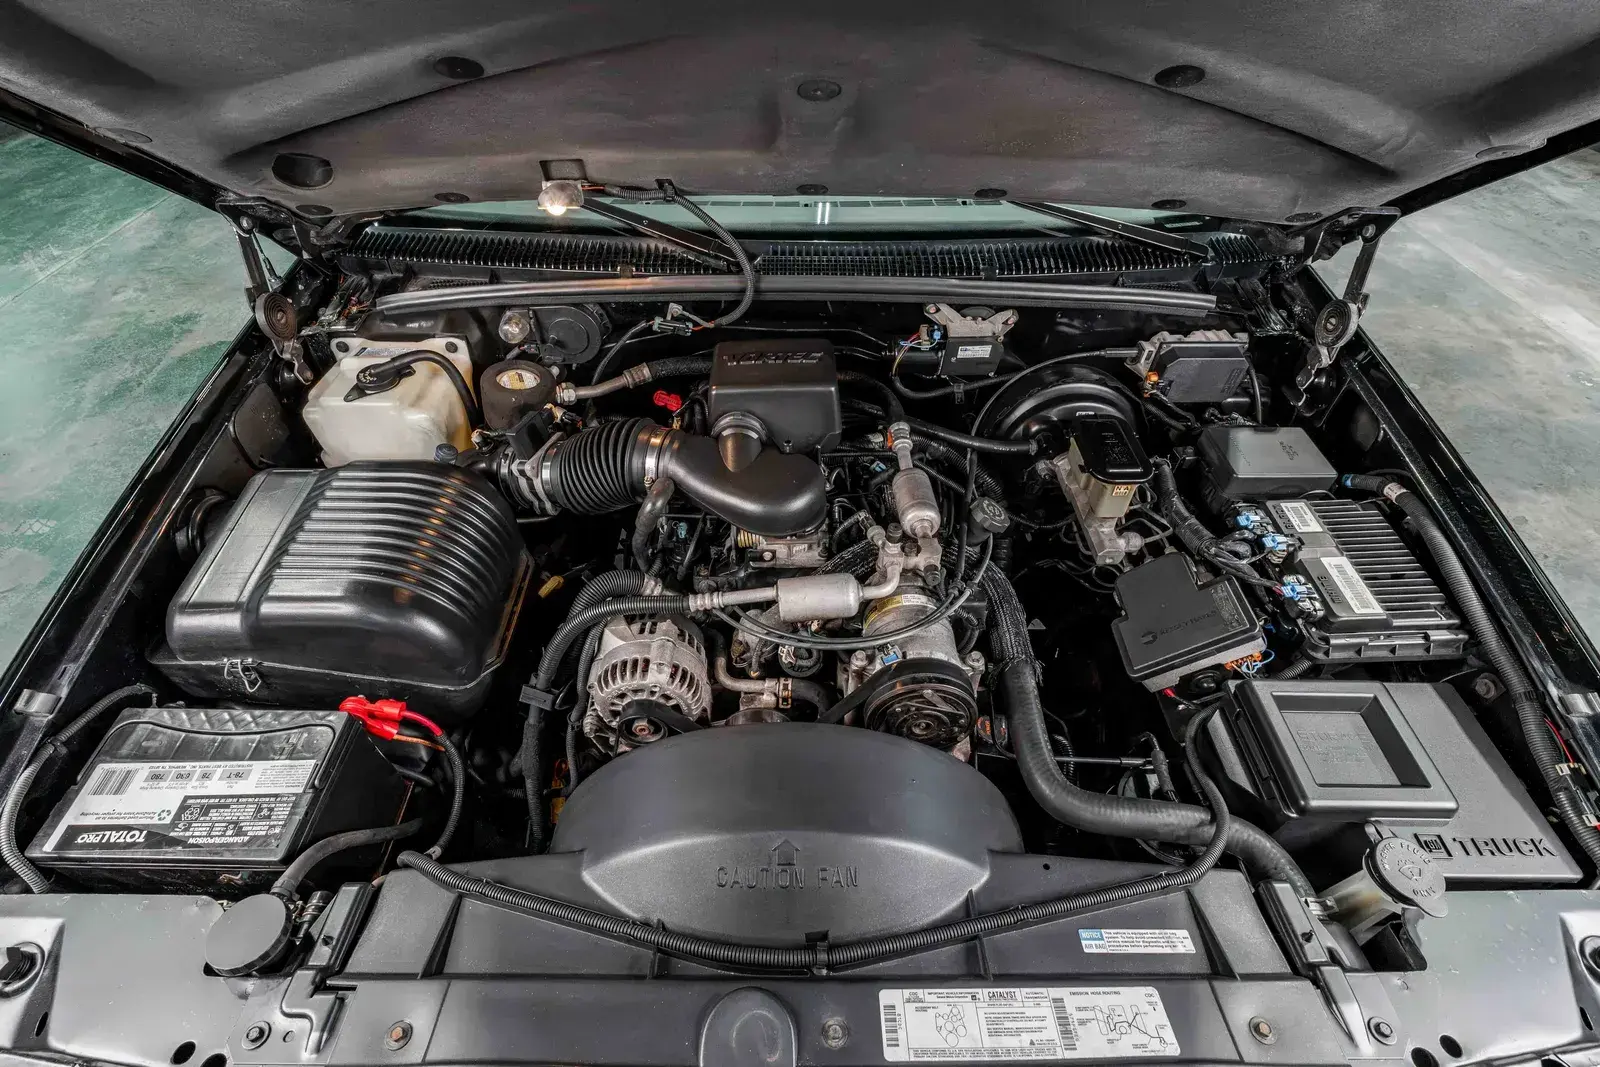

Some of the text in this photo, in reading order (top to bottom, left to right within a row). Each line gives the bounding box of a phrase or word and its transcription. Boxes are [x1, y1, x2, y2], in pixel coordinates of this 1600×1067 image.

[226, 771, 245, 780] 78-T
[76, 830, 148, 843] TOTALPRO
[188, 836, 244, 844] DANGER/POISON
[1453, 836, 1557, 857] TRUCK
[1379, 842, 1431, 870] WASHER FLUID
[716, 865, 859, 889] CAUTION FAN
[987, 990, 1016, 998] CATALYST
